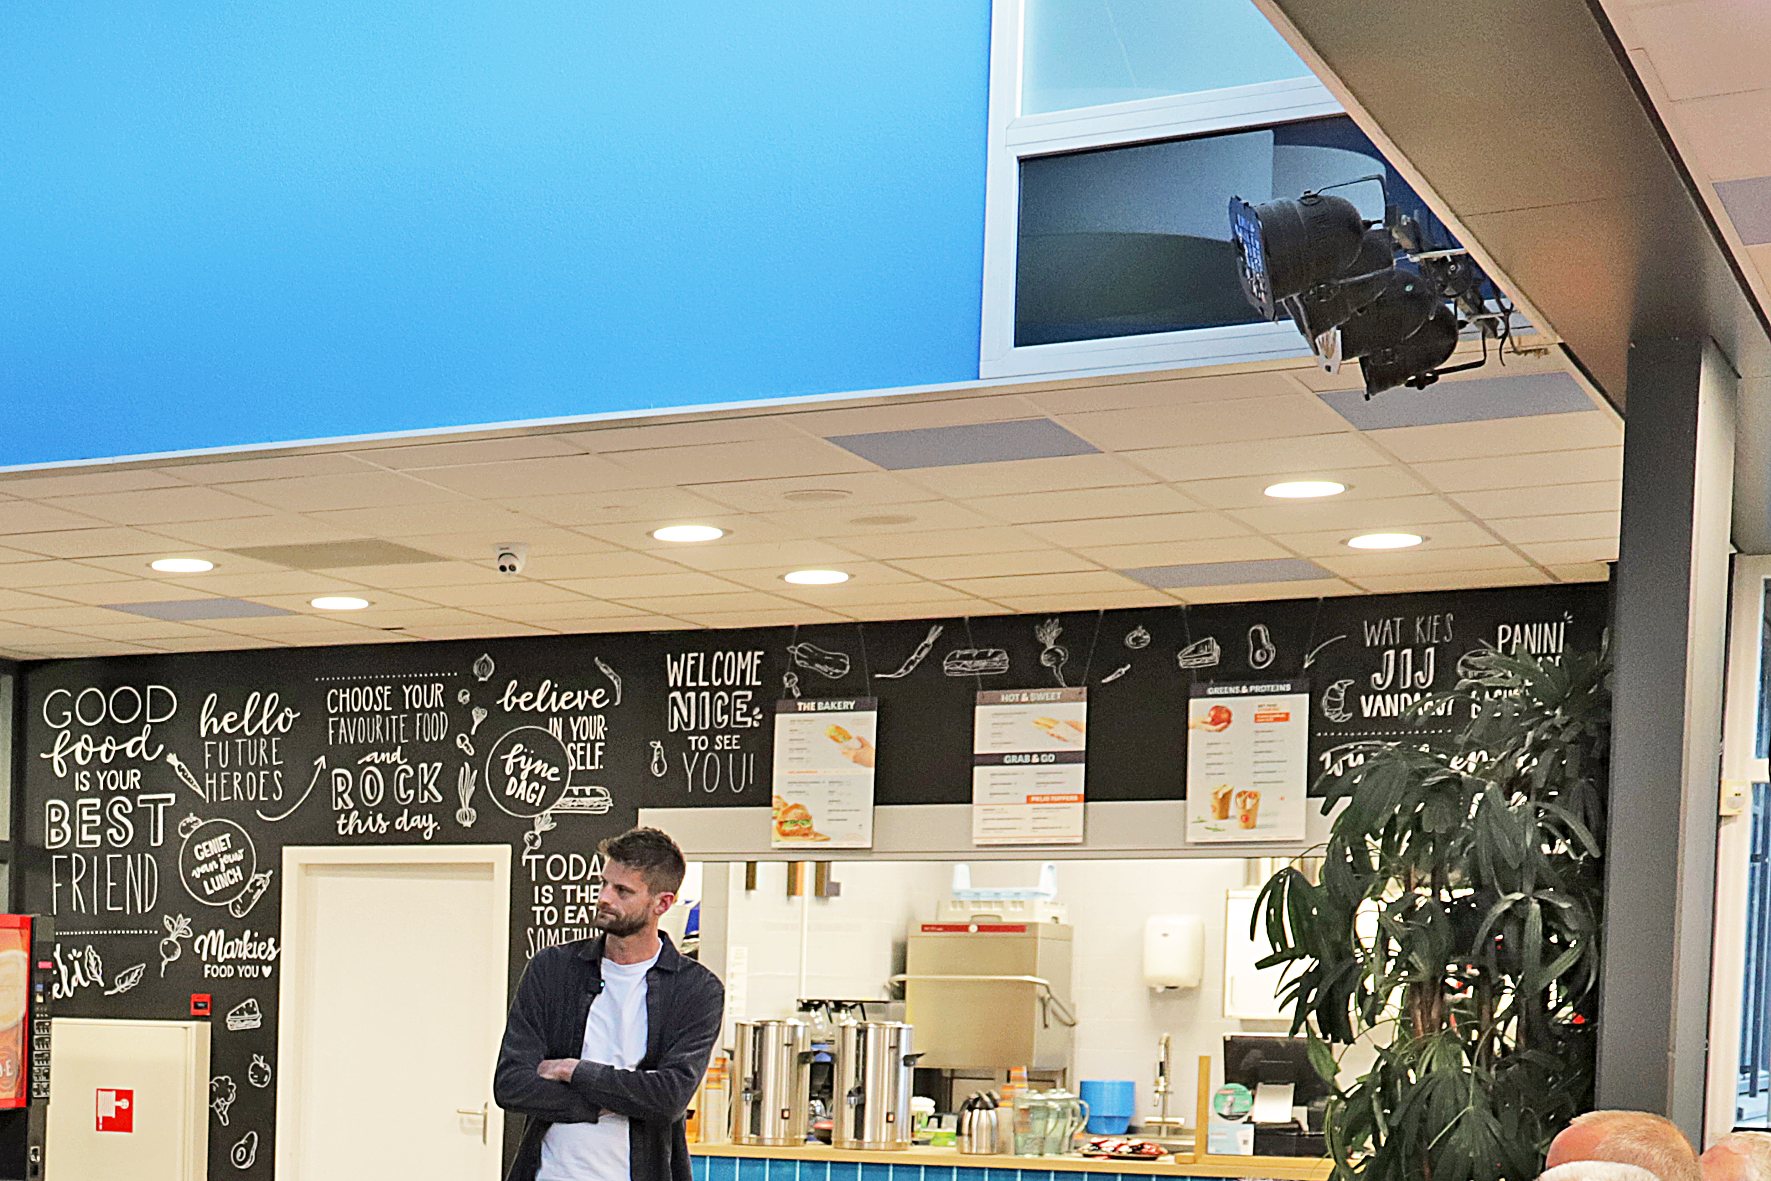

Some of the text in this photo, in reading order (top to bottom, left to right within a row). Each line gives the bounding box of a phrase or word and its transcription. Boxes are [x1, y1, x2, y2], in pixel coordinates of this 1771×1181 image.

[1363, 613, 1454, 647] WAT KIES
[1497, 622, 1565, 655] PANINI
[666, 651, 765, 688] WELCOME
[1370, 647, 1435, 690] JIJ
[327, 683, 445, 713] CHOOSE YOUR
[496, 679, 610, 713] believe
[1001, 693, 1021, 702] HOT
[1029, 692, 1062, 702] SWEET
[1207, 685, 1240, 695] GREENS
[1249, 683, 1291, 693] PROTEINS
[43, 685, 177, 729] GOOD
[200, 692, 301, 737] hello
[668, 690, 753, 732] NICE
[797, 700, 856, 712] THE BAKERY
[328, 711, 449, 746] FAVOURITE FOOD
[549, 717, 563, 741] IN
[688, 735, 741, 750] TO SEE
[40, 724, 164, 778] food
[204, 738, 283, 769] FUTURE
[357, 746, 408, 765] and
[500, 743, 561, 782] fijne
[1003, 754, 1030, 764] GRAB
[1040, 753, 1056, 763] GO
[75, 769, 141, 791] IS YOUR
[205, 770, 283, 803] HEROES
[331, 762, 443, 810] ROCK
[506, 777, 547, 807] DAG!
[45, 793, 176, 849] BEST
[337, 809, 441, 840] this day.
[194, 833, 232, 861] GENIET
[191, 848, 245, 878] van jouw
[522, 853, 603, 881] TODA
[52, 853, 158, 915] FRIEND
[203, 865, 244, 896] LUNCH
[534, 884, 601, 904] IS THE
[531, 906, 558, 925] TO
[194, 929, 281, 962] Markies
[204, 963, 259, 978] FOOD YOU
